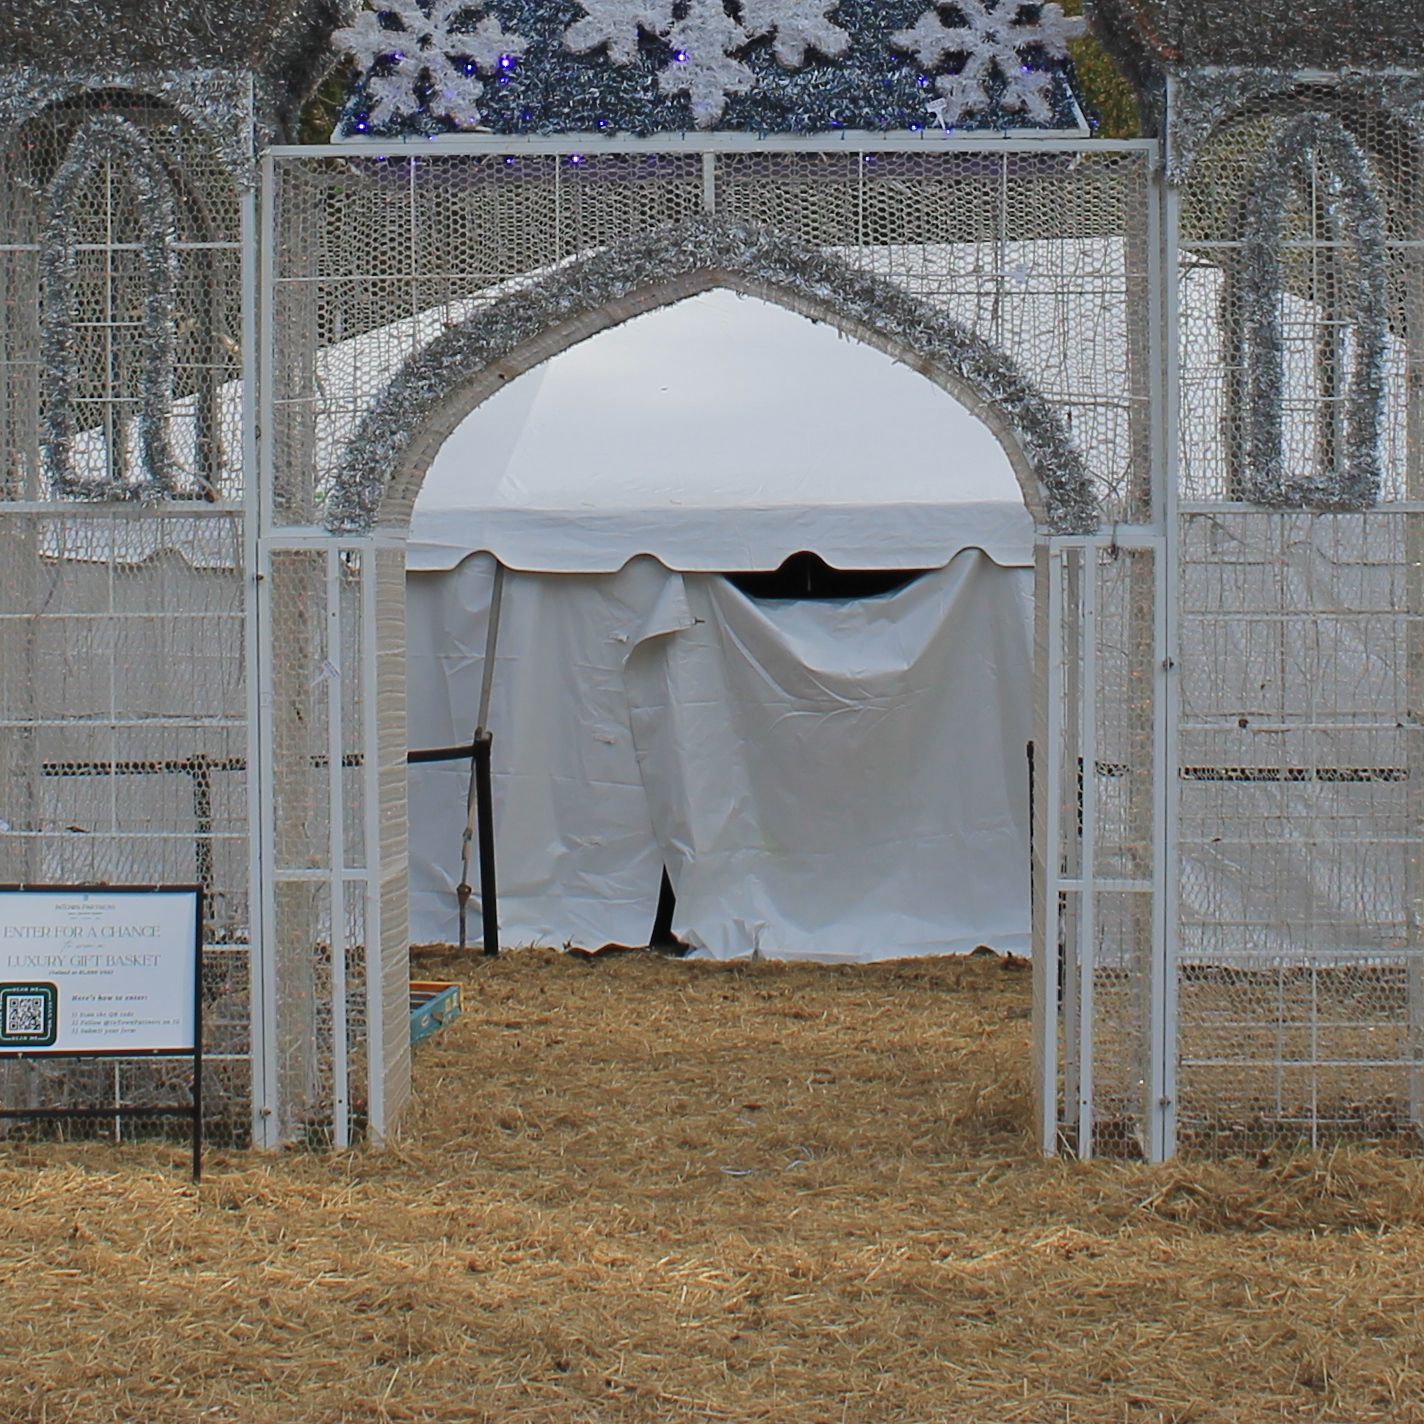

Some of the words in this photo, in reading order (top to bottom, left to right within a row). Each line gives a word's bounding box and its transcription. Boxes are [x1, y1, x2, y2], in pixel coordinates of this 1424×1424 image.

[3, 925, 51, 938] ENTER
[54, 926, 83, 938] FOR
[86, 926, 97, 938] A
[100, 925, 161, 937] CHANCE
[7, 955, 66, 968] LUXURY
[70, 954, 103, 967] GIFT
[106, 954, 162, 967] BASKET
